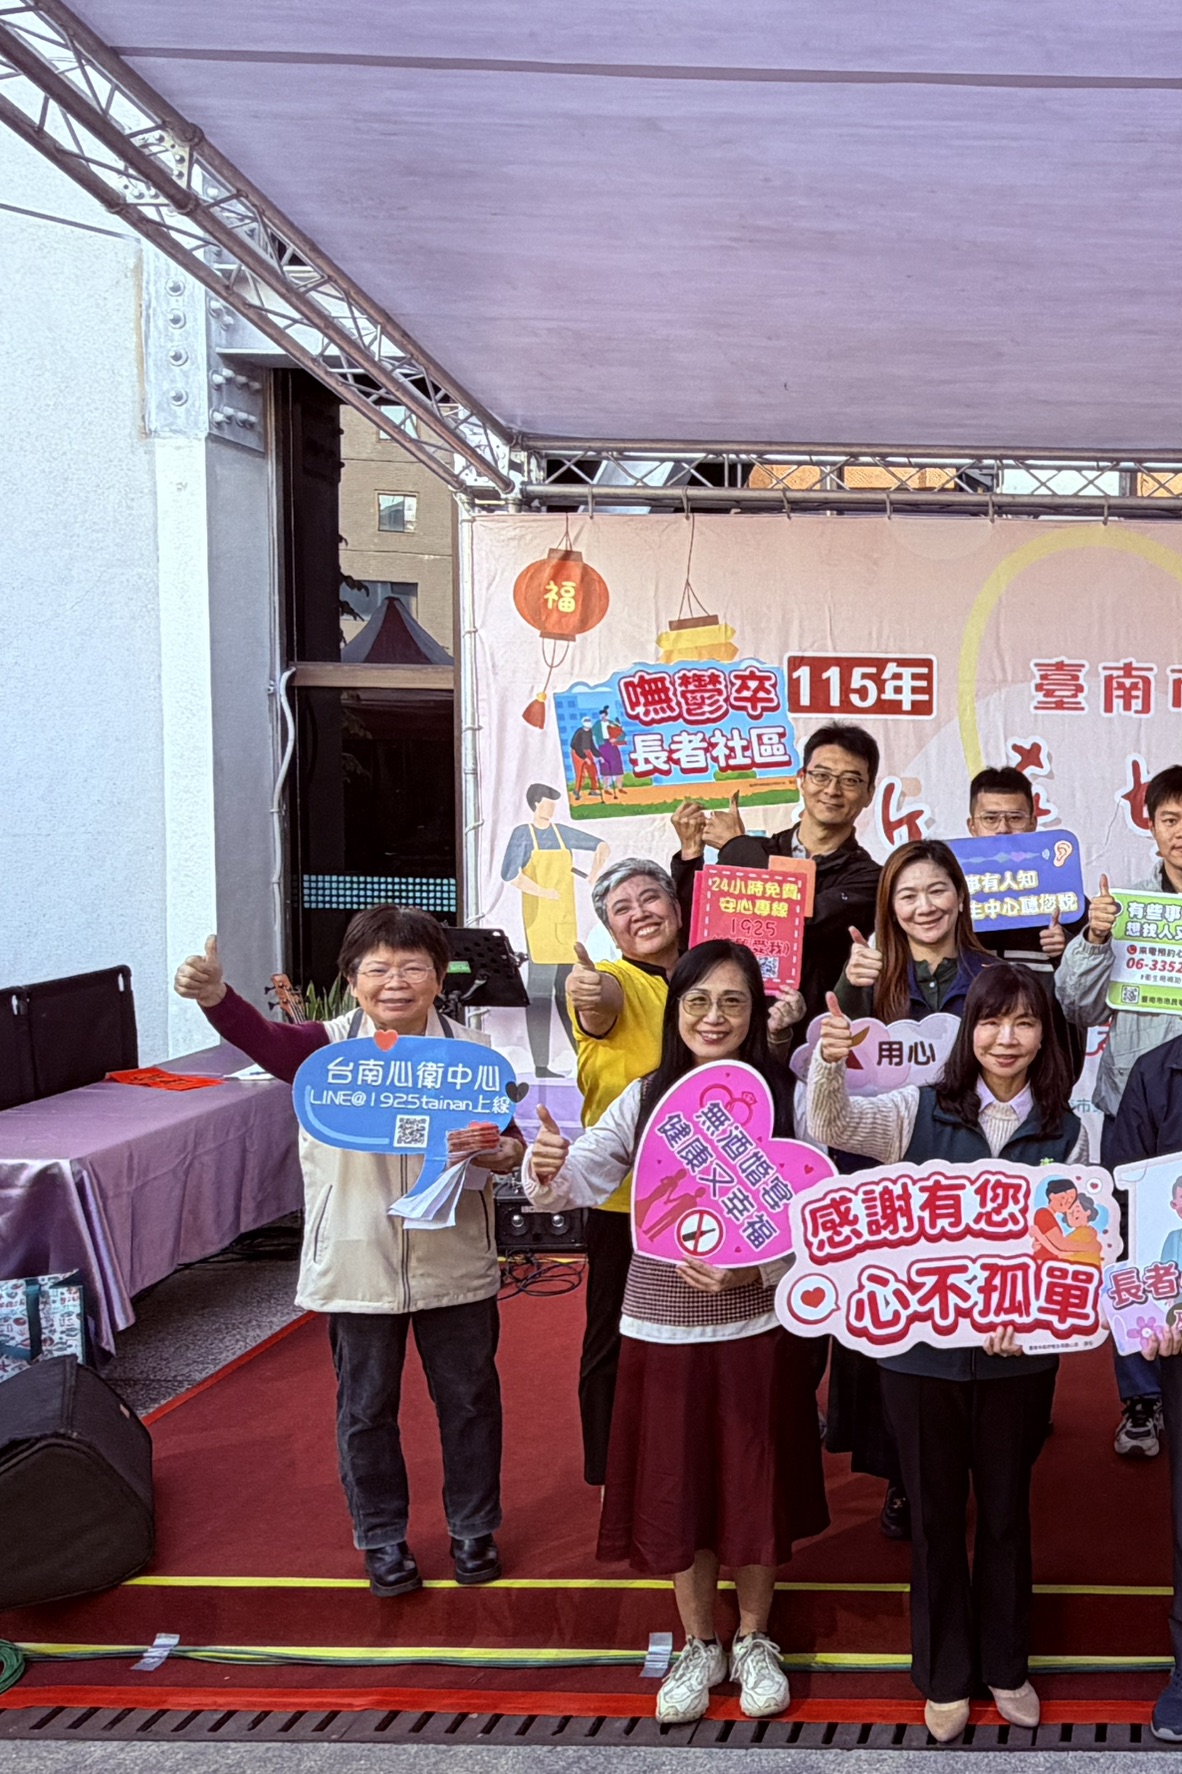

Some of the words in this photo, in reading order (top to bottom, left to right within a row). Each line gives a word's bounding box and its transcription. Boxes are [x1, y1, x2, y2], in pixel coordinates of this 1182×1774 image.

[543, 580, 577, 613] 福
[791, 661, 930, 711] 115年
[630, 725, 791, 774] 長者社區
[710, 877, 799, 900] 24小時免費
[719, 896, 788, 918] 安心專線
[731, 918, 777, 937] 1925
[876, 1041, 936, 1067] 用心
[327, 1057, 501, 1092] 台南心衛中心
[309, 1089, 510, 1114] LINE@1925tainan上線
[694, 1101, 795, 1213] 無酒婚宴
[656, 1112, 779, 1250] 健康又幸福
[807, 1175, 1025, 1252] 感謝有您
[852, 1262, 1095, 1331] 心不孤單
